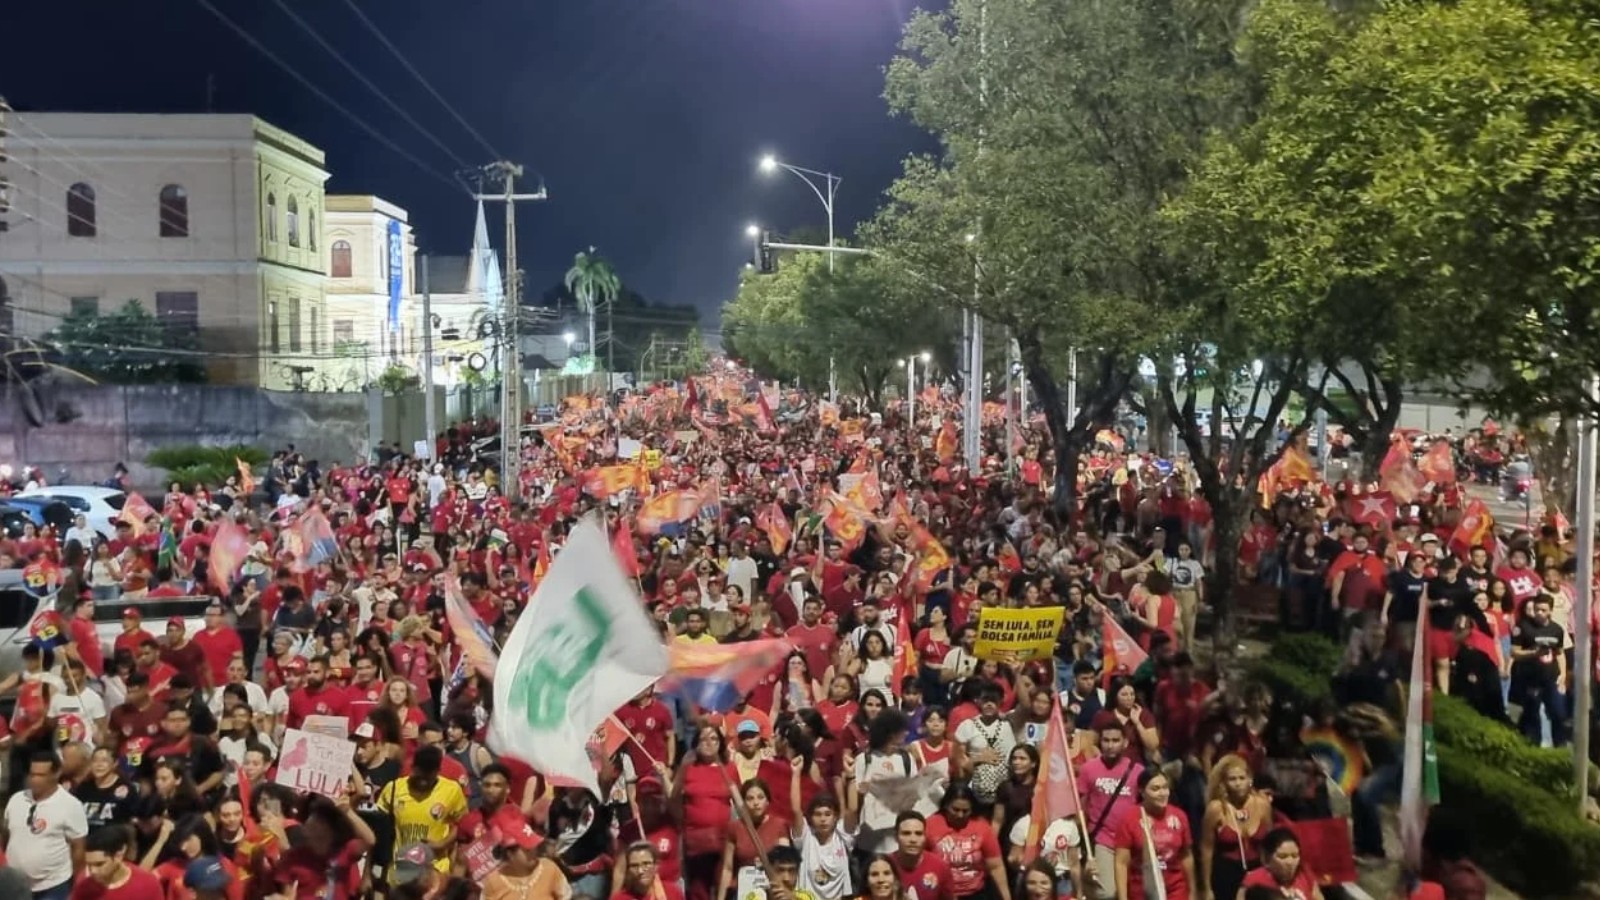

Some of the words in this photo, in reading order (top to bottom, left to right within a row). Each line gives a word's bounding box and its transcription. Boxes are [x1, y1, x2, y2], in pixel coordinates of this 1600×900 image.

[984, 620, 1004, 631] SEM
[1036, 619, 1055, 629] SEM
[981, 631, 1014, 642] BOLSA
[295, 769, 343, 797] LULA
